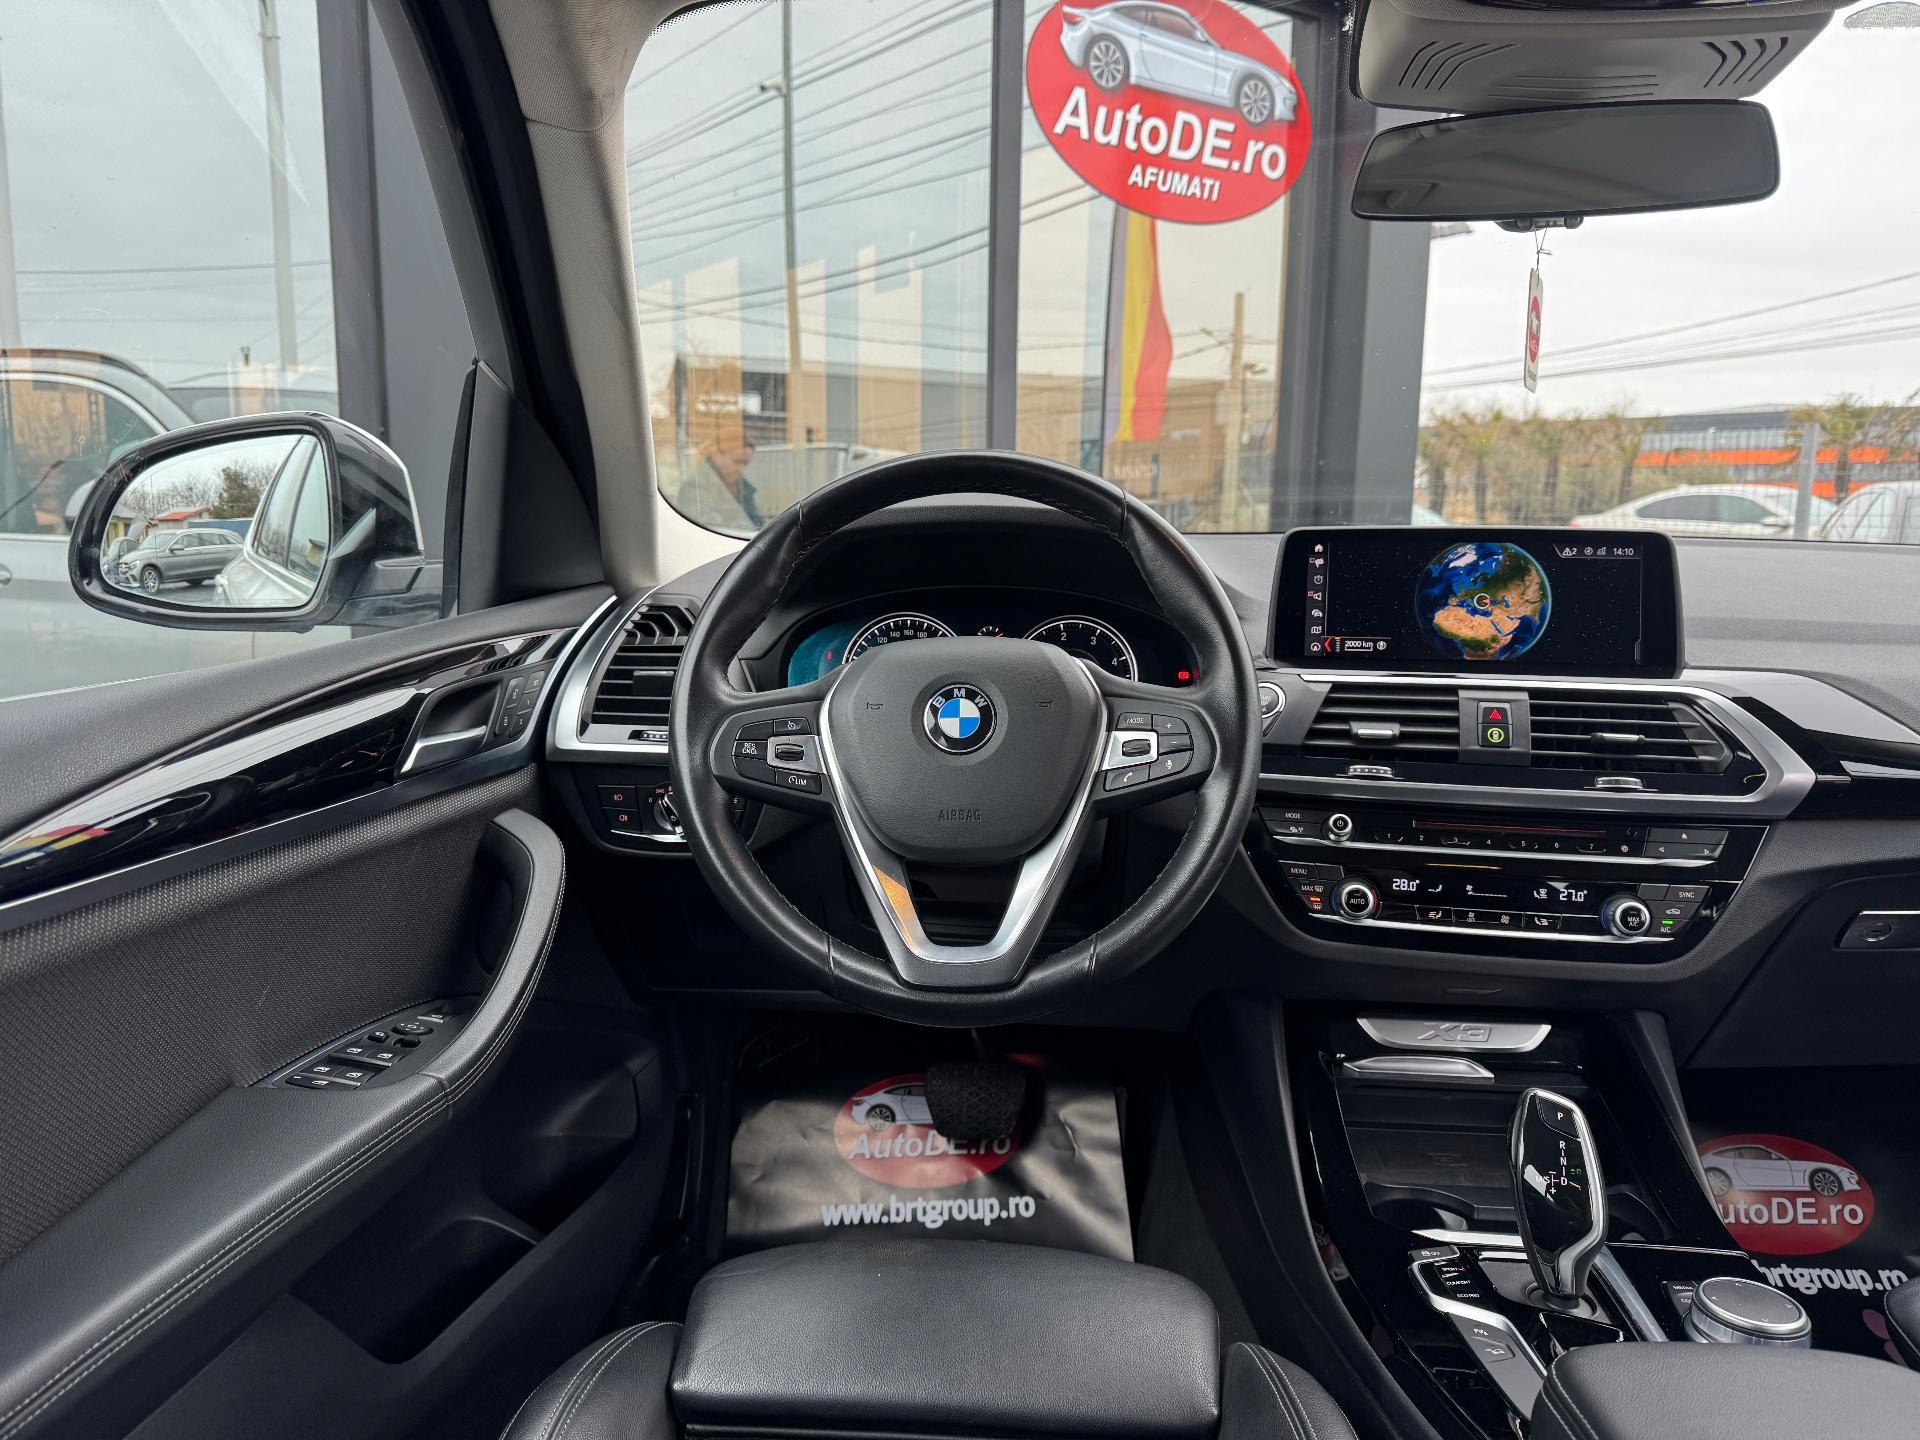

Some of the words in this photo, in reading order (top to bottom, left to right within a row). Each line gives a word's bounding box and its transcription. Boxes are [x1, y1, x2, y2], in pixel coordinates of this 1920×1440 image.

[1053, 86, 1288, 181] AutoDE.ro
[1128, 163, 1222, 202] AFUMATI
[1613, 547, 1634, 556] 14:10
[1060, 632, 1067, 641] 2
[1090, 636, 1097, 645] 3
[1345, 640, 1361, 648] 2000
[1362, 640, 1374, 648] km
[1111, 657, 1118, 666] 4
[932, 688, 988, 709] BMW
[938, 809, 982, 821] AIRBAG
[1301, 884, 1314, 892] MAX
[1678, 891, 1695, 899] SYNC
[1350, 897, 1366, 905] AUTO
[1417, 1022, 1492, 1042] X3
[1557, 1112, 1564, 1120] P
[1559, 1141, 1566, 1150] R
[1560, 1156, 1567, 1166] N
[1560, 1176, 1568, 1186] D
[821, 1194, 1036, 1229] www.brtgroup.ro
[1718, 1197, 1865, 1226] utoDE.ro
